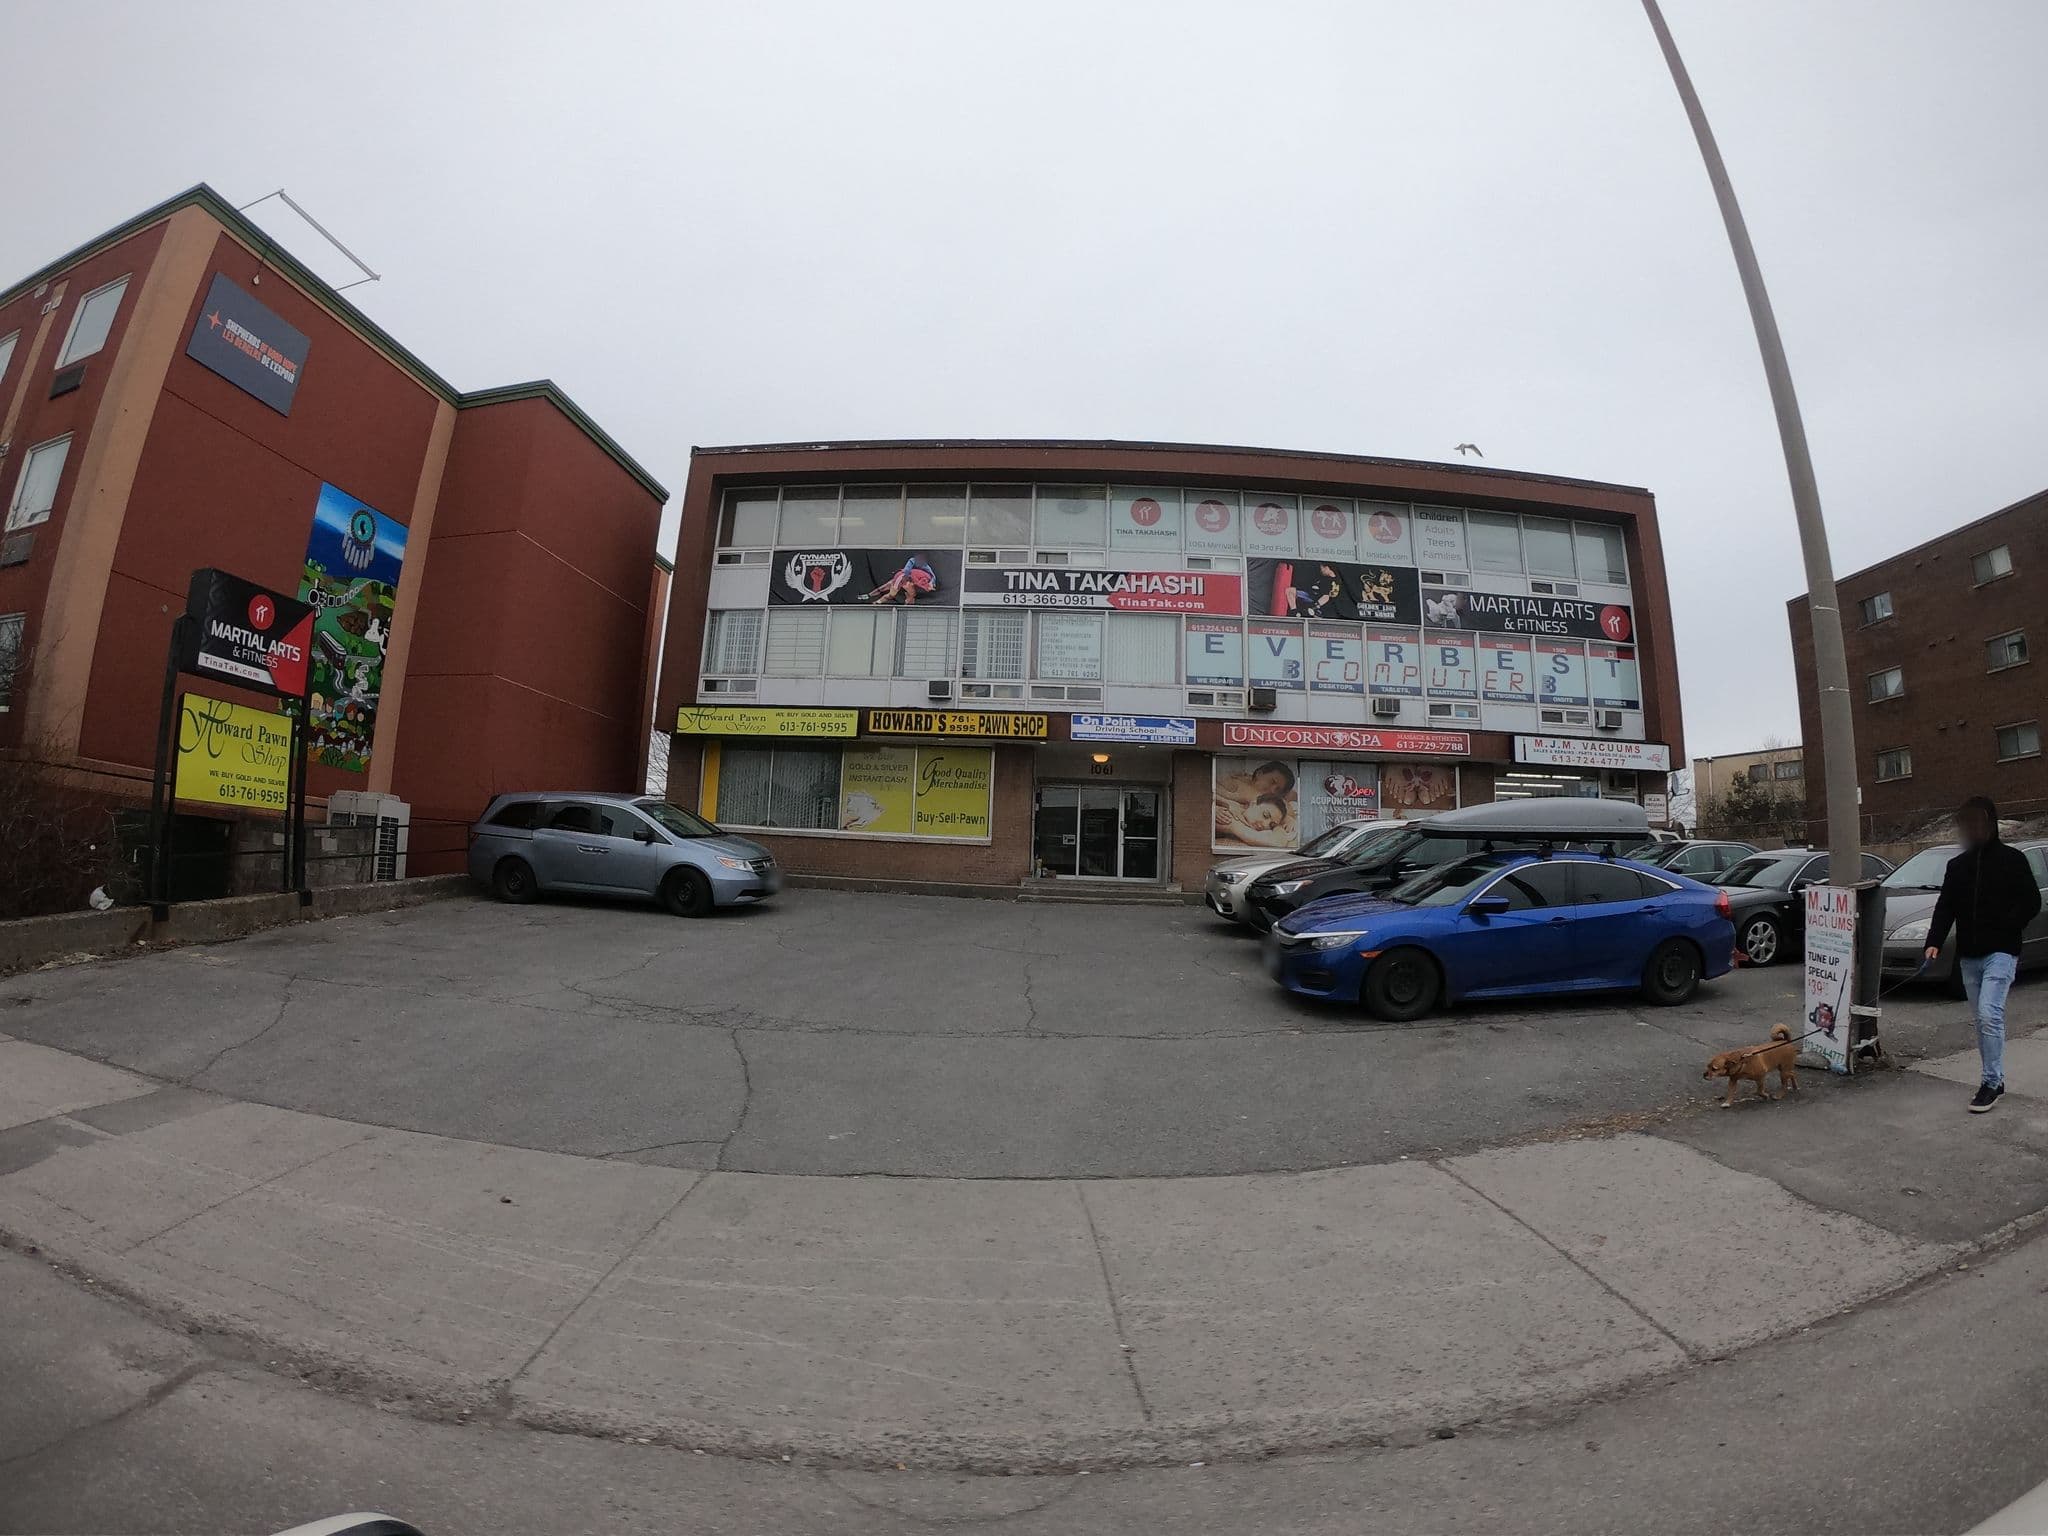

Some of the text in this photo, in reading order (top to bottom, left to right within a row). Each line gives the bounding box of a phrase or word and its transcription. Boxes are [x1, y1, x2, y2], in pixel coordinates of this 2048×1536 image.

[225, 319, 261, 349] SHEPHERDS
[222, 329, 234, 342] LES
[261, 354, 269, 367] DE
[1420, 512, 1458, 522] Children
[1116, 528, 1177, 537] TINA TAKAHASHI
[1425, 525, 1455, 535] Adults
[1427, 538, 1455, 548] Teens
[1423, 550, 1461, 561] Families
[1004, 571, 1205, 596] TINA TAKAHASHI
[1003, 593, 1095, 606] 613-366-0981
[1117, 597, 1205, 609] TinaTak.com
[1470, 594, 1596, 621] MARTIAL ARTS
[1504, 618, 1568, 634] & FITNESS
[211, 619, 301, 662] MARTIAL ARTS
[232, 645, 278, 668] & FITNESS
[203, 656, 261, 679] TinaTak.com
[677, 708, 767, 731] Howard Pawn
[779, 721, 848, 733] 613-761-9595
[872, 712, 947, 733] HOWARD'S
[952, 715, 975, 724] 761-
[978, 715, 1044, 736] PAWN SHOP
[1080, 716, 1137, 727] On Point
[180, 700, 288, 759] Howard Pawn
[726, 722, 768, 734] Shop
[949, 724, 976, 733] 9595
[1095, 725, 1126, 734] Driving
[1230, 726, 1383, 748] UNICORN SPA
[1396, 740, 1464, 751] 613-729-7788
[1534, 738, 1641, 754] M.J.M. VACUUMS
[241, 742, 287, 774] Shop
[1551, 755, 1626, 766] 613-724-4777
[881, 764, 908, 772] SILVER
[1091, 765, 1113, 775] 1061
[209, 769, 285, 787] WE BUY GOLD AND SILVER
[849, 774, 908, 784] INSTANT CASH
[917, 757, 988, 797] Good Quality
[932, 778, 988, 790] Merchandise
[219, 783, 285, 804] 613-761-9595
[1352, 788, 1376, 797] OPEN
[1311, 797, 1368, 806] ACUPUNCTURE
[1808, 891, 1852, 915] M.J.M.
[1807, 913, 1852, 932] VACUUMS
[1808, 951, 1840, 967] TUNE UP
[1808, 966, 1837, 982] SPECIAL
